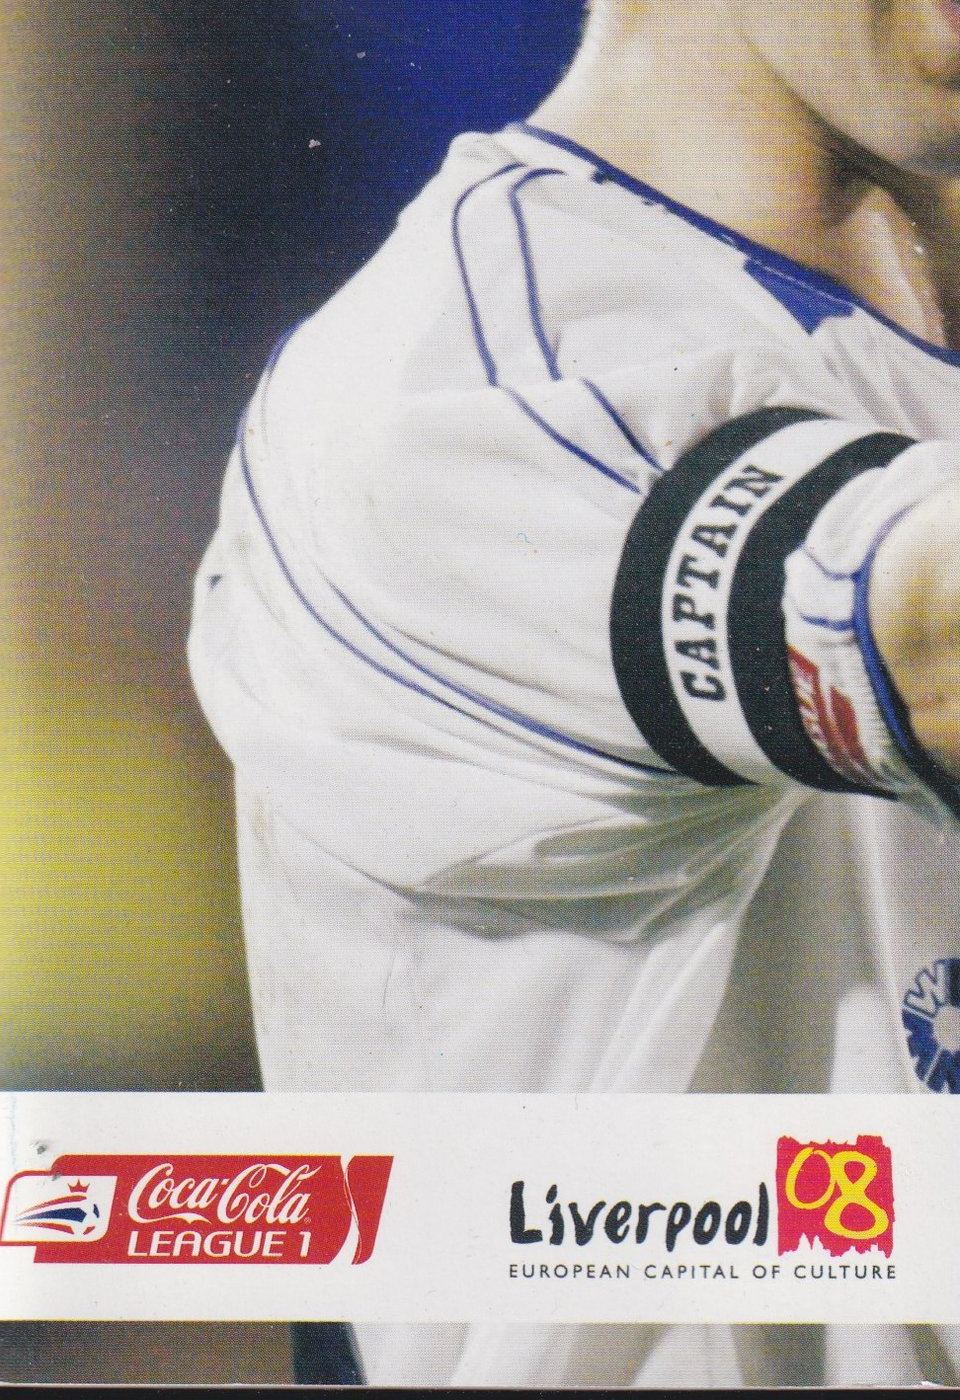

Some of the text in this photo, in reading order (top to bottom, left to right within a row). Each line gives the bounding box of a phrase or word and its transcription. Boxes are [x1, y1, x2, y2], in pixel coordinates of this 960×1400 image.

[672, 463, 785, 703] CAPTAIN
[127, 1163, 322, 1224] Coca-Cola
[509, 1147, 889, 1252] Liverpool 08
[127, 1231, 312, 1257] LEAGUE 1
[509, 1264, 896, 1280] EUROPEAN CAPITAL OF CULTURE
